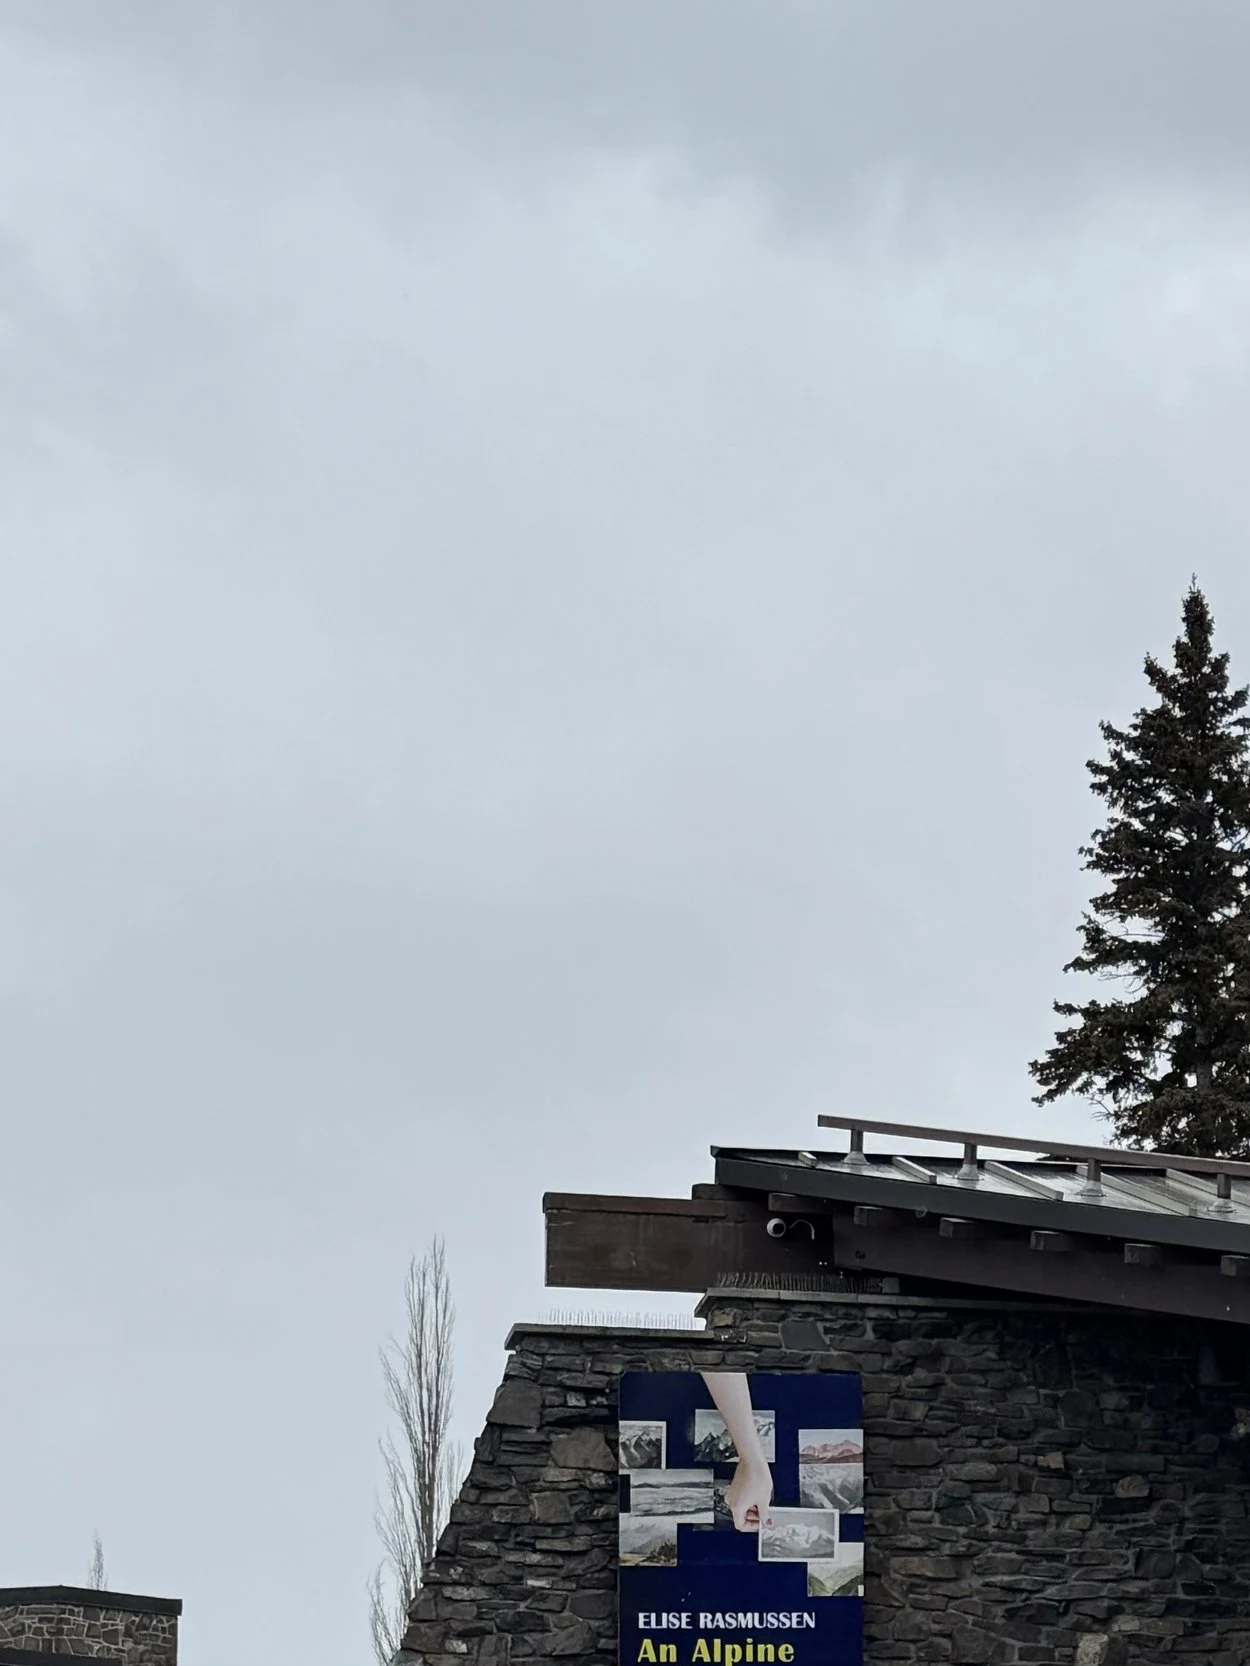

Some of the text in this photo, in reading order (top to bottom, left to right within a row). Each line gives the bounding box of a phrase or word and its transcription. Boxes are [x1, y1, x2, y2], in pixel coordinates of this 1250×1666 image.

[638, 1612, 816, 1629] ELISE RASMUSSEN
[637, 1638, 677, 1663] An
